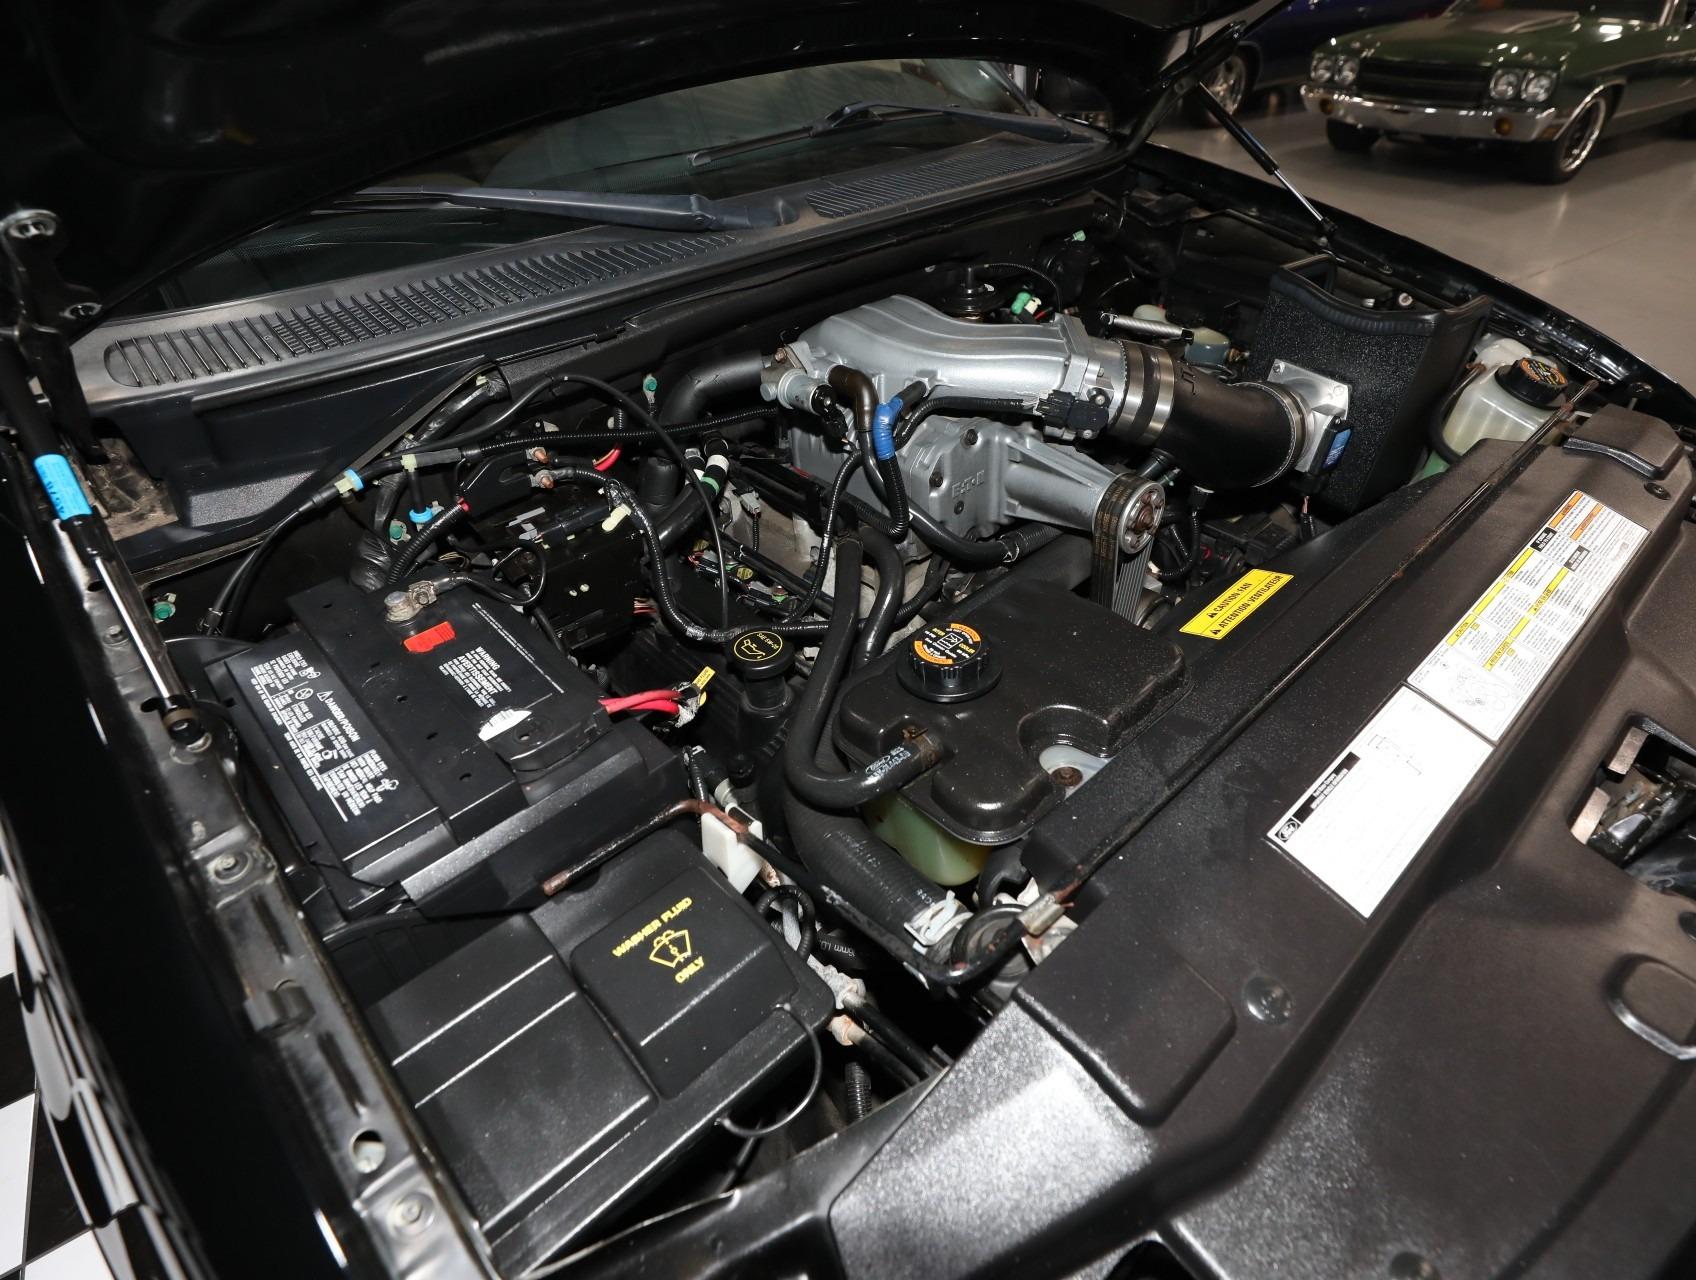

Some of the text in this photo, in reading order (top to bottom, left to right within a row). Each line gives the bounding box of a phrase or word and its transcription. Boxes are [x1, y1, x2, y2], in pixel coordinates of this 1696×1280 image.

[1214, 582, 1252, 612] CAUTION FAN
[1218, 575, 1284, 629] ATTENTION VENTILATEUR
[457, 655, 499, 695] AVERTISSEMENT
[475, 646, 501, 671] WARNING
[324, 697, 361, 742] DANGER/POISON
[612, 897, 693, 957] WASHER FLUID
[675, 955, 705, 984] ONLY
